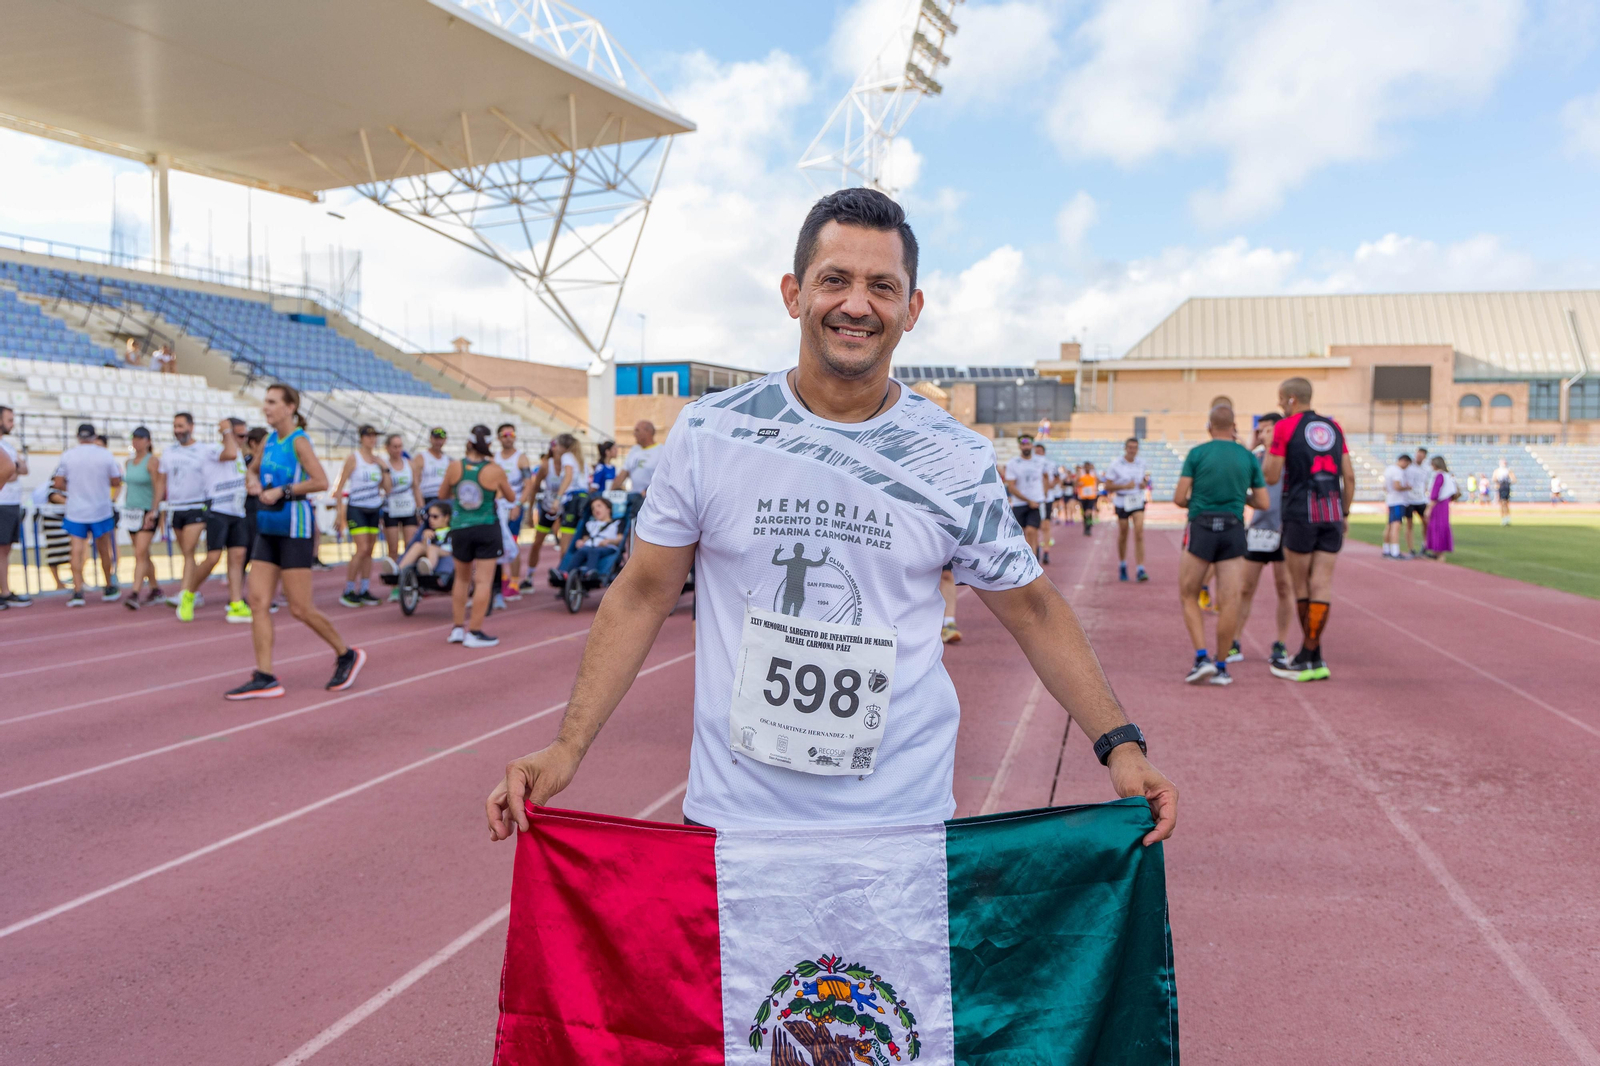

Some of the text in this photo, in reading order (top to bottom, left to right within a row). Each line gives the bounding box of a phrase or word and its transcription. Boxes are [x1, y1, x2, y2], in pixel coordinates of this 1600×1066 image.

[757, 498, 894, 527] MEMORIAL
[753, 527, 892, 550] DE MARINA CARMONA PAEZ
[754, 515, 892, 539] SARGENTO DE INFANTERIA
[818, 582, 845, 590] FERNANDO
[828, 556, 845, 571] CLUB
[844, 569, 863, 606] CARMONA
[750, 616, 894, 648] XXXV MEMORIAL SARGENTO DE INFANTERÍA DE MARINA
[785, 635, 852, 653] RAFAEL CARMONA PÁEZ
[763, 656, 862, 719] 598
[759, 717, 777, 728] OSCAR
[776, 722, 808, 735] MARTINEZ
[807, 729, 845, 739] HERNANDEZ
